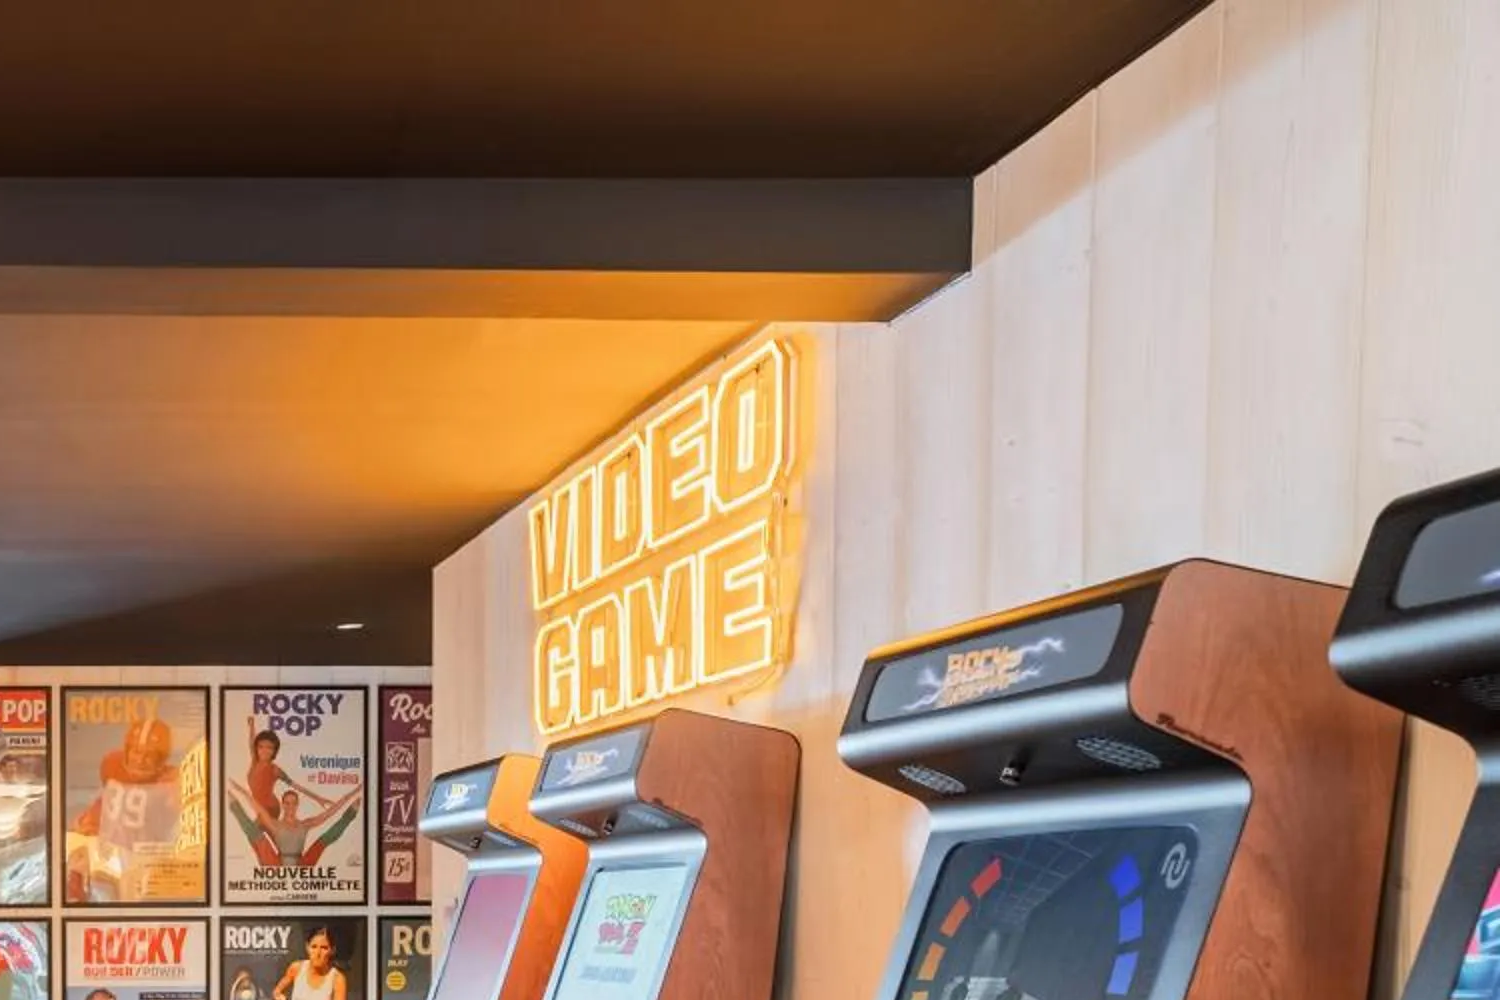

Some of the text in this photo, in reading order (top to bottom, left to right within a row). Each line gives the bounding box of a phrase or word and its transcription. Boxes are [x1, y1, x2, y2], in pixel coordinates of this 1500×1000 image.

[528, 339, 784, 611] VIDEO
[534, 518, 773, 735] GAME
[70, 696, 159, 724] ROCKY
[253, 693, 344, 715] ROCKY
[269, 716, 322, 736] POP
[318, 772, 359, 785] Davina
[384, 794, 414, 825] TV
[253, 867, 337, 879] NOUVELLE
[84, 928, 187, 965] ROCKY
[224, 926, 291, 949] ROCKY
